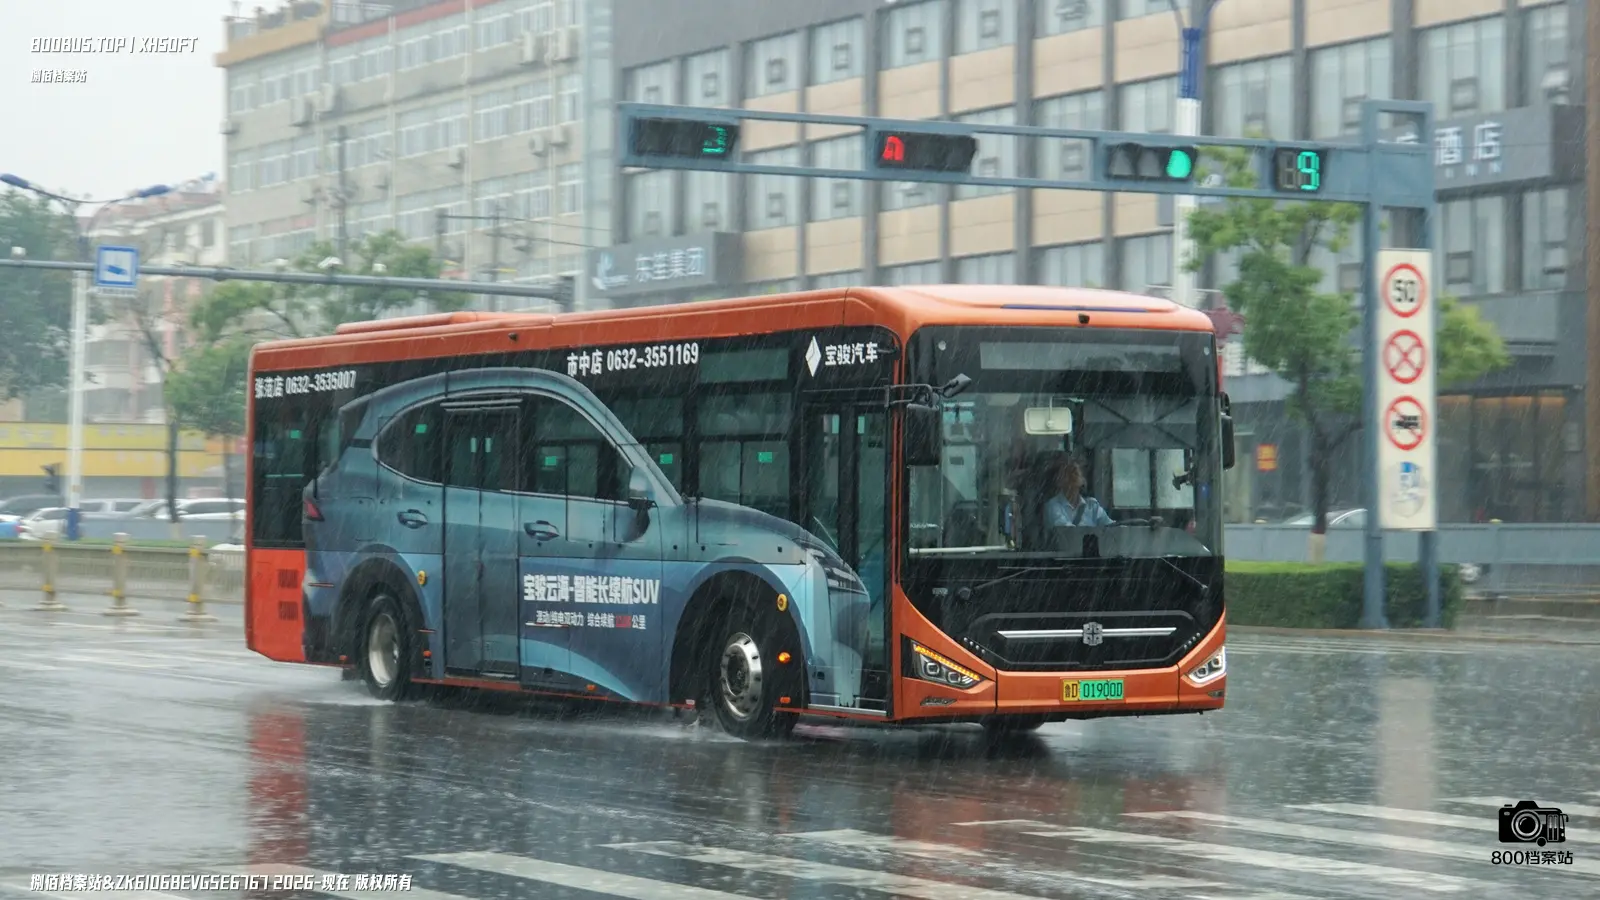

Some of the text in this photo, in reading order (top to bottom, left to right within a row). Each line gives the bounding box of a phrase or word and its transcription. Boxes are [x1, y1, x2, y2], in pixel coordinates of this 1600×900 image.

[1297, 151, 1320, 191] 9
[566, 342, 699, 377] 市中店 0632-3551169
[825, 341, 878, 366] 宝骏汽车
[285, 371, 357, 395] 0632-3535007
